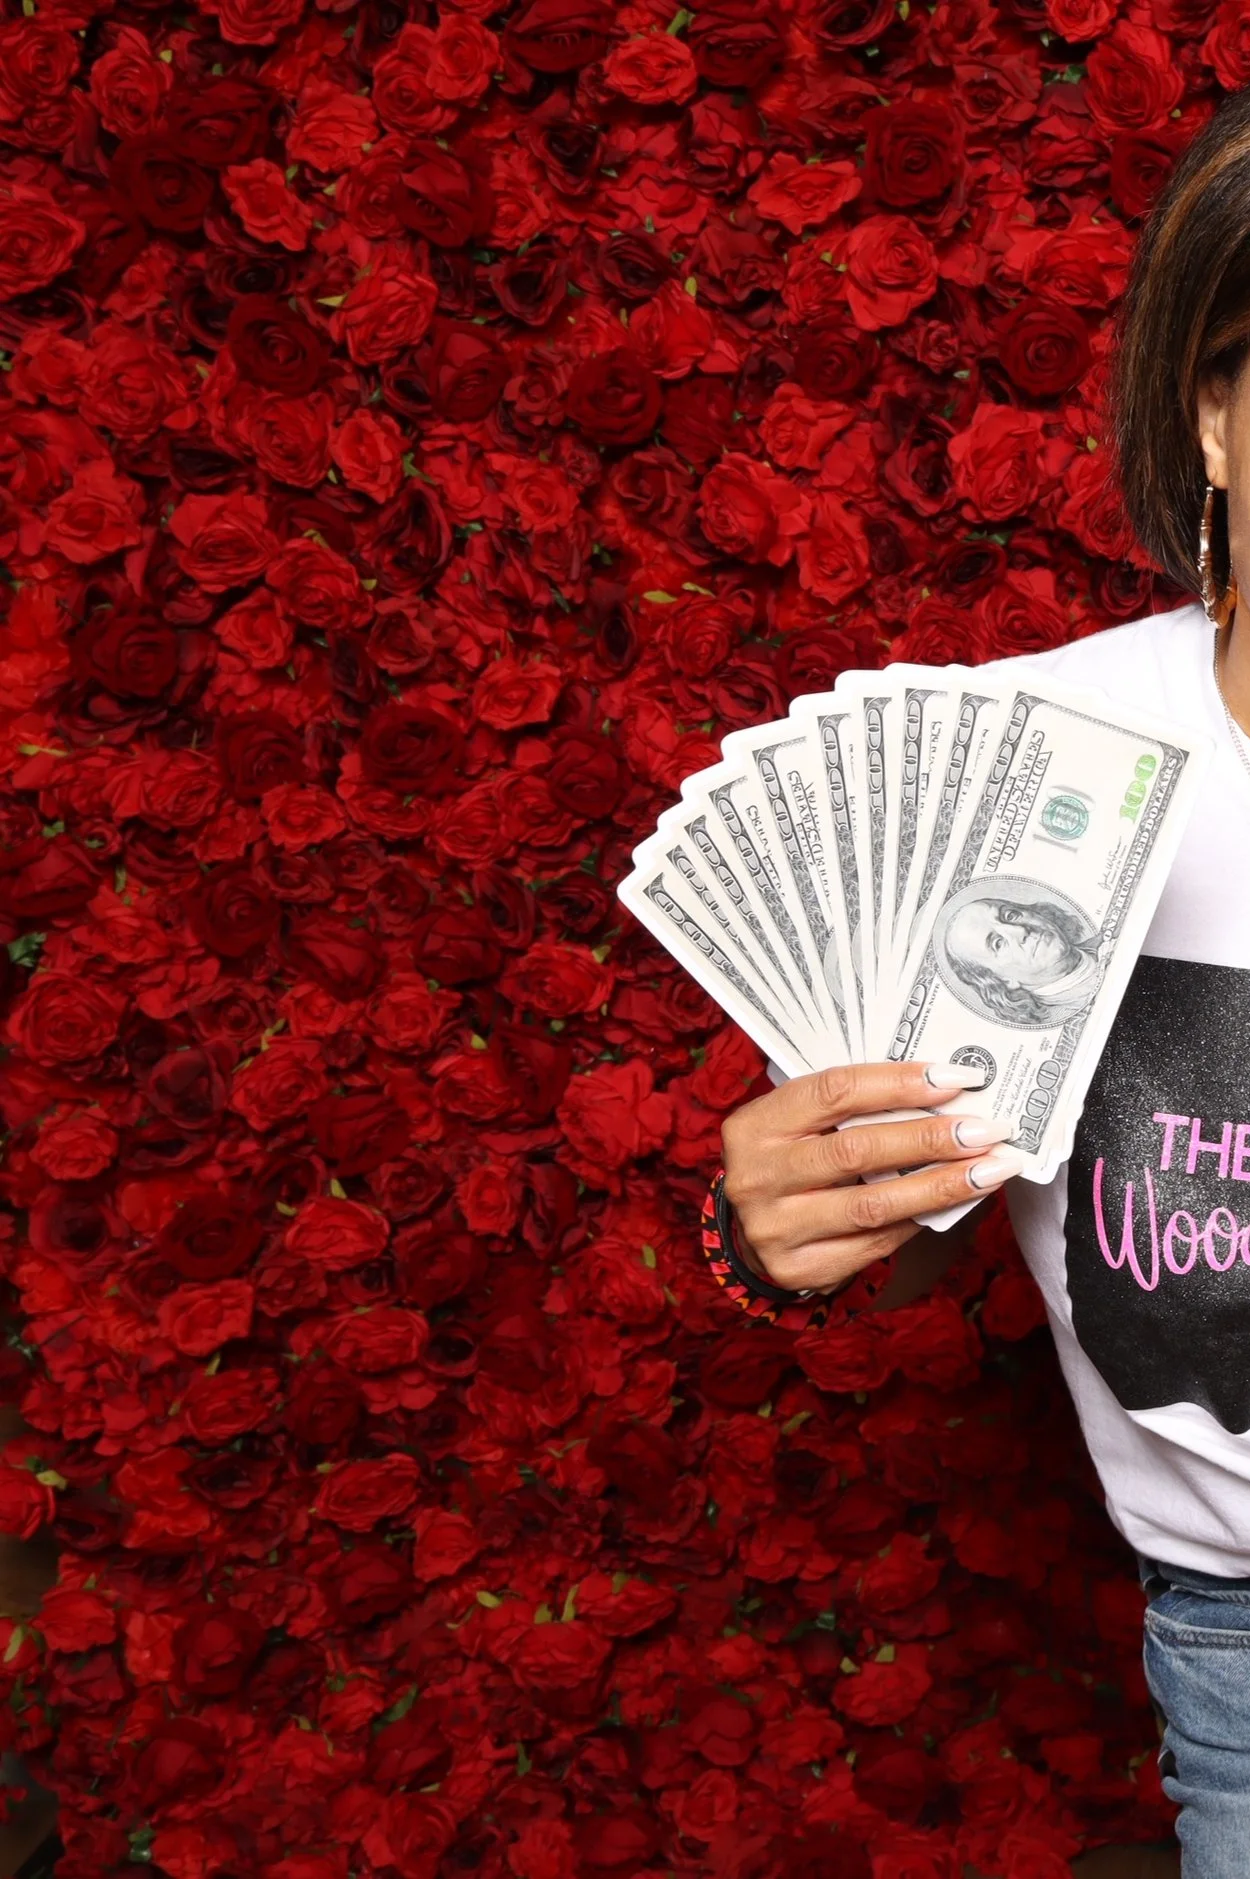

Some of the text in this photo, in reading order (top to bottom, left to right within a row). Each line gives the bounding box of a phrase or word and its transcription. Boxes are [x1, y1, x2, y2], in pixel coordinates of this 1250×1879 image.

[823, 726, 850, 831] 100
[866, 708, 885, 814] 100
[902, 700, 921, 803] 100
[941, 704, 975, 808] 100
[983, 703, 1027, 805] 100
[1119, 753, 1154, 822] 100
[717, 797, 773, 892] 100
[760, 759, 803, 860] 100
[692, 830, 756, 920] 100
[652, 891, 729, 967] 100
[886, 983, 925, 1061] 00
[1019, 1059, 1058, 1136] 100
